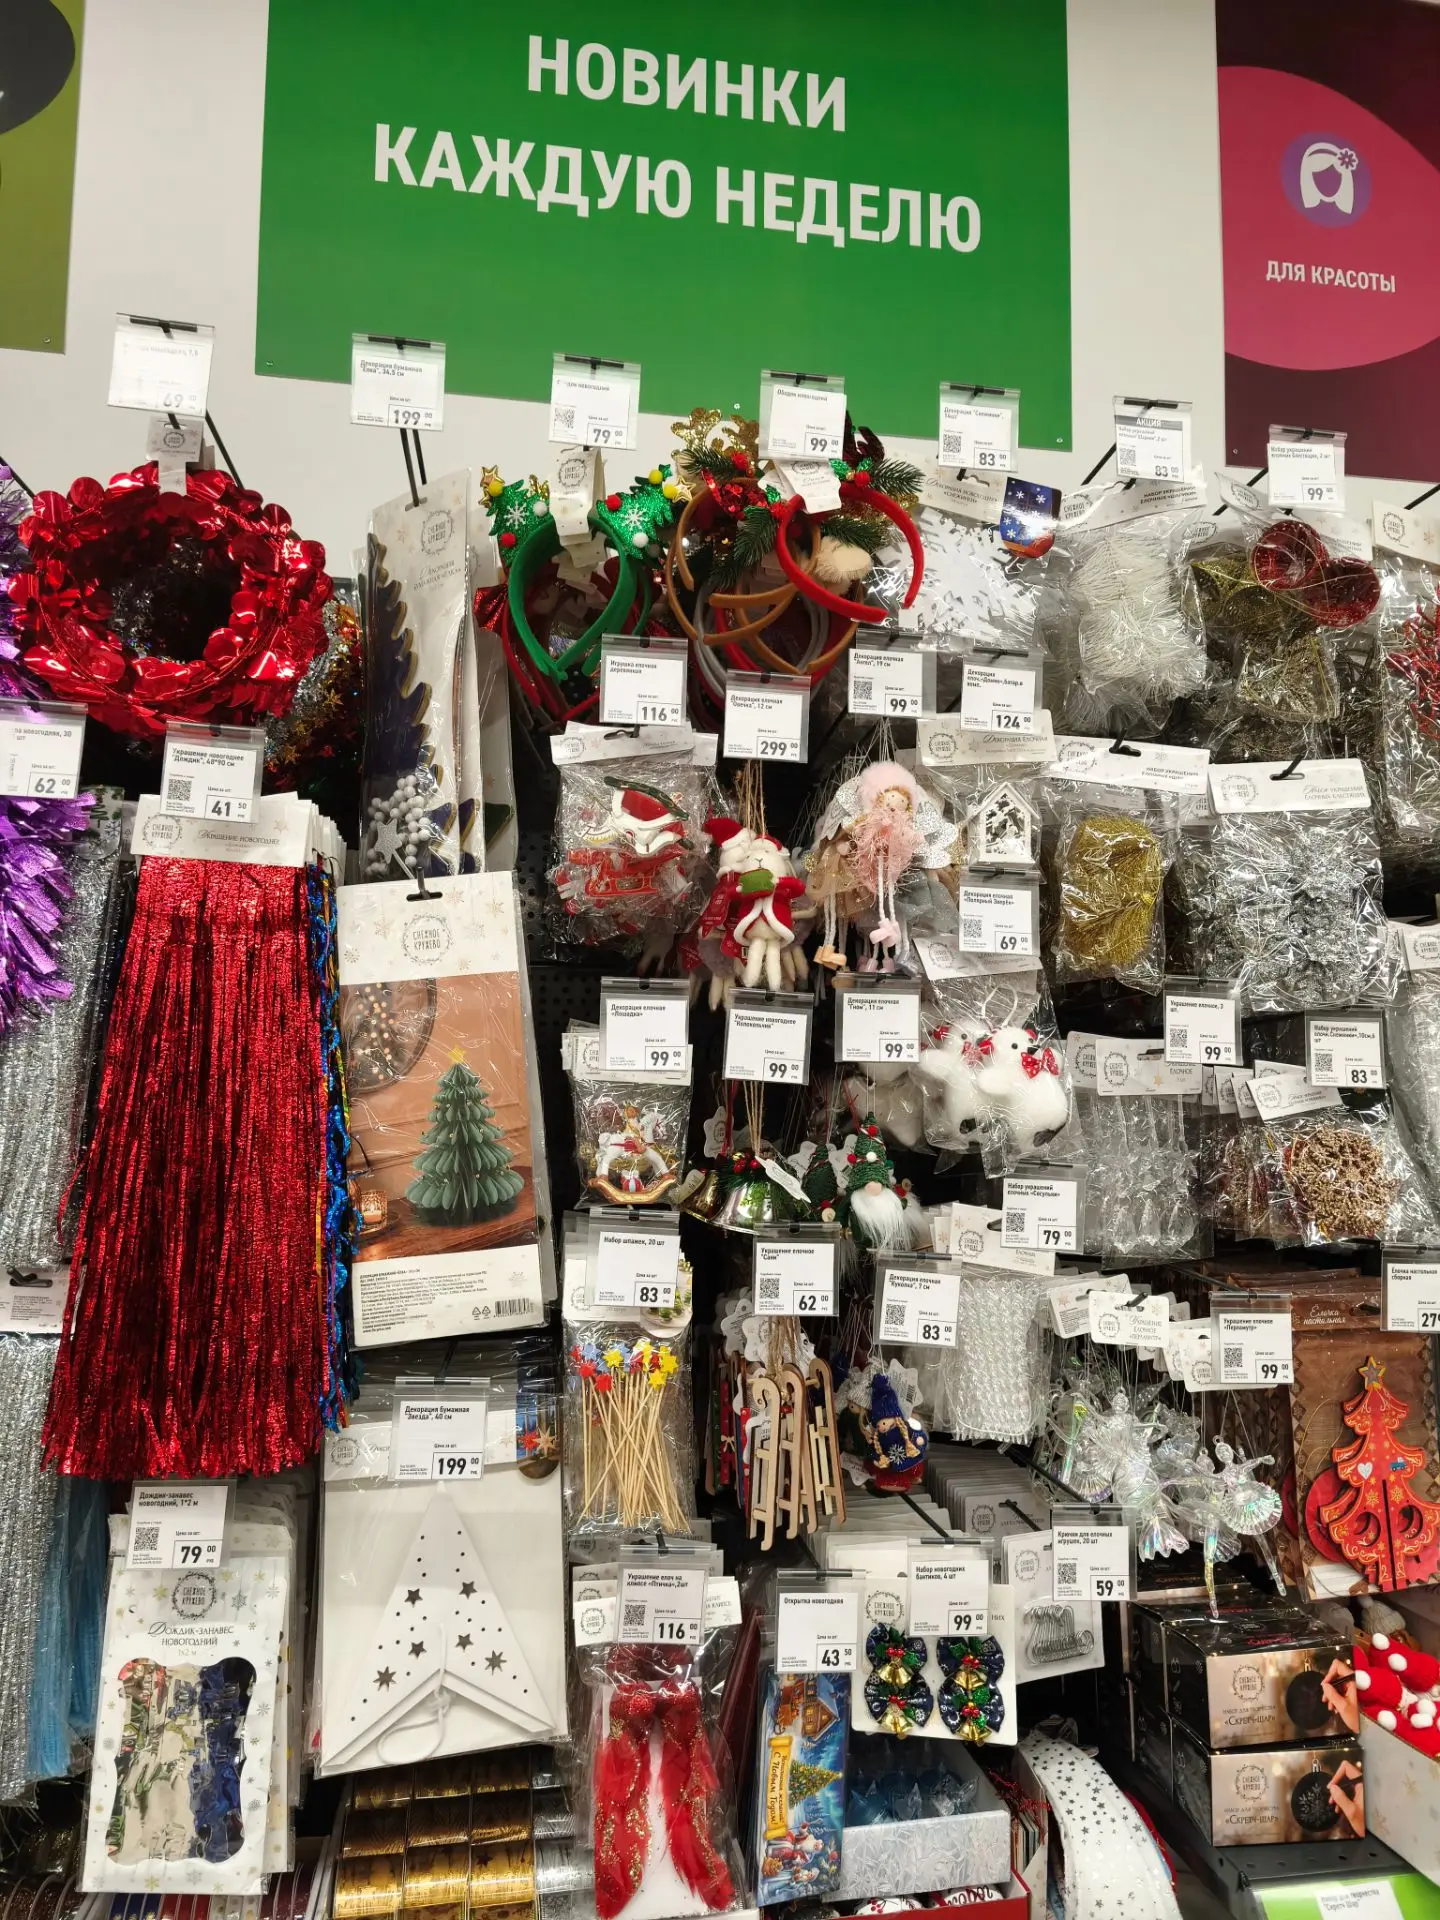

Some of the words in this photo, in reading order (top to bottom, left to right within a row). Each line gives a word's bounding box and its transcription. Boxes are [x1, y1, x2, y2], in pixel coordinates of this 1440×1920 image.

[528, 34, 846, 132] НОВИНКИ
[374, 123, 692, 219] КАЖДУЮ
[715, 166, 981, 253] НЕДЕЛЮ
[1265, 260, 1305, 282] ДЛЯ
[1311, 265, 1396, 293] КРАСОТЫ
[393, 410, 420, 425] 199
[593, 429, 610, 443] 79
[811, 438, 827, 452] 99
[979, 453, 995, 466] 83
[1155, 466, 1168, 477] 83
[1308, 488, 1323, 500] 99
[854, 652, 882, 661] Декорация
[611, 660, 633, 669] Игрушка
[967, 669, 995, 677] Декорация
[731, 695, 762, 704] Декорация
[890, 699, 906, 712] 99
[641, 706, 667, 721] 116
[996, 715, 1020, 729] 124
[172, 748, 207, 757] Украшение
[760, 741, 787, 756] 299
[36, 778, 55, 793] 62
[212, 802, 231, 817] 41
[1000, 936, 1017, 949] 69
[611, 1004, 641, 1012] Декорация
[1171, 1000, 1197, 1008] Украшение
[735, 1014, 764, 1022] Украшение
[885, 1043, 902, 1058] 99
[1205, 1046, 1221, 1060] 99
[651, 1051, 669, 1065] 99
[770, 1063, 787, 1078] 99
[1351, 1070, 1367, 1083] 83
[1008, 1183, 1023, 1191] Набор
[1043, 1230, 1060, 1245] 79
[889, 1274, 918, 1283] Декорация
[640, 1287, 658, 1302] 83
[799, 1295, 816, 1310] 62
[1422, 1313, 1440, 1328] 27
[923, 1325, 939, 1340] 83
[1262, 1364, 1278, 1378] 99
[405, 1405, 439, 1415] Декорация
[440, 1406, 469, 1414] бумажная
[439, 1458, 467, 1475] 199
[140, 1491, 193, 1501] Дождик-занавес
[182, 1546, 202, 1563] 79
[628, 1573, 659, 1582] Украшение
[1096, 1580, 1113, 1596] 59
[784, 1597, 810, 1605] Открытка
[954, 1615, 972, 1630] 99
[659, 1622, 685, 1639] 116
[822, 1649, 839, 1666] 43
